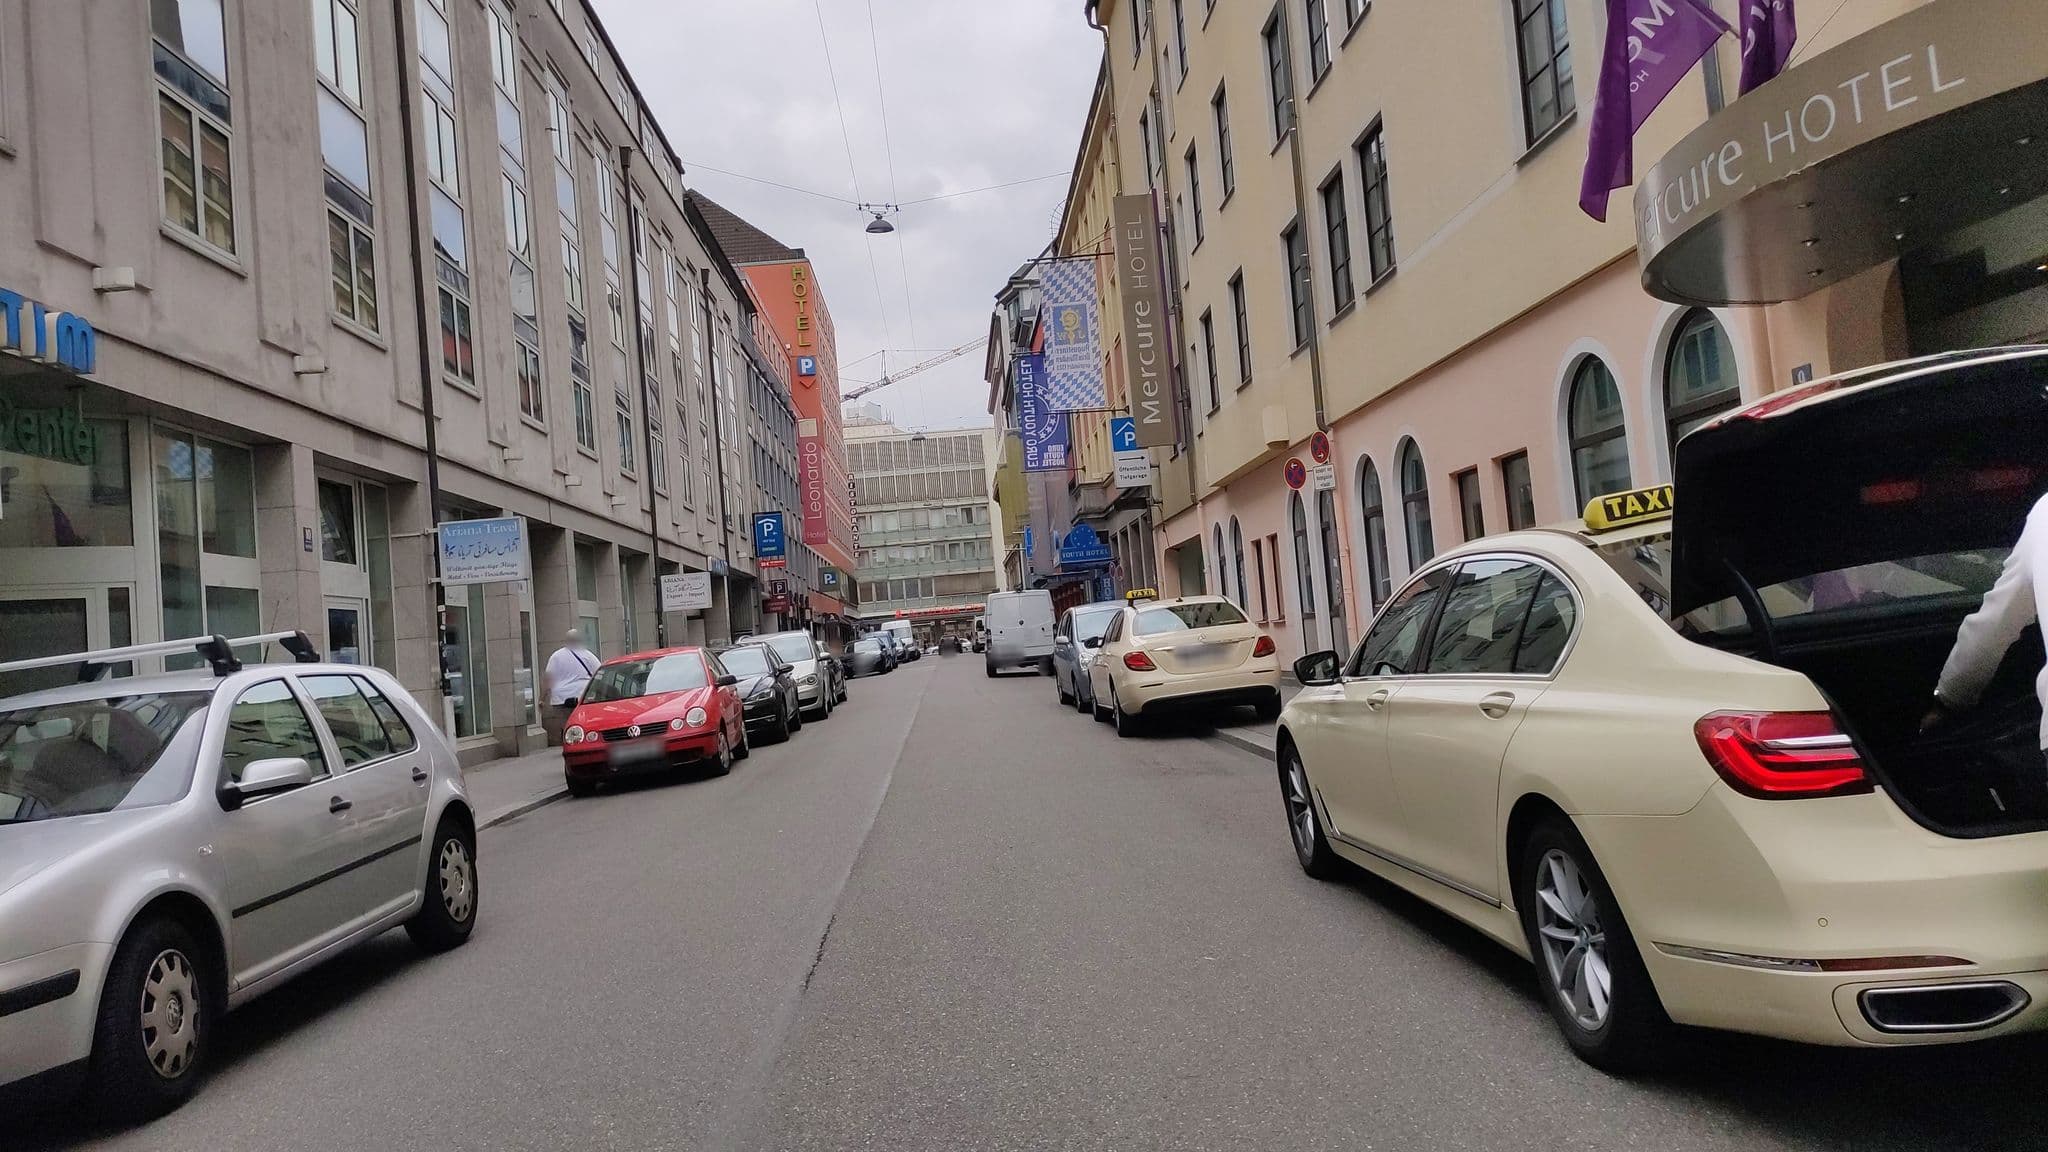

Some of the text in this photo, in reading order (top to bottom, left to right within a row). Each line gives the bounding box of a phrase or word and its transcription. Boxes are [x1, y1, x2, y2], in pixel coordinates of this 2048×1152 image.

[1643, 44, 1966, 242] ercure HOTEL
[791, 266, 811, 347] HOTEL
[1127, 213, 1162, 425] Mercure HOTEL
[801, 359, 812, 374] P
[1125, 431, 1136, 447] P
[803, 442, 822, 519] Leonardo
[1605, 487, 1673, 518] TAXI
[848, 473, 860, 558] RISTORANTE
[443, 521, 518, 537] Ariana Travel
[763, 522, 773, 537] P
[807, 531, 826, 539] Hotel
[1086, 549, 1108, 557] HOTEL
[824, 573, 833, 585] P
[1132, 590, 1152, 598] TAXI
